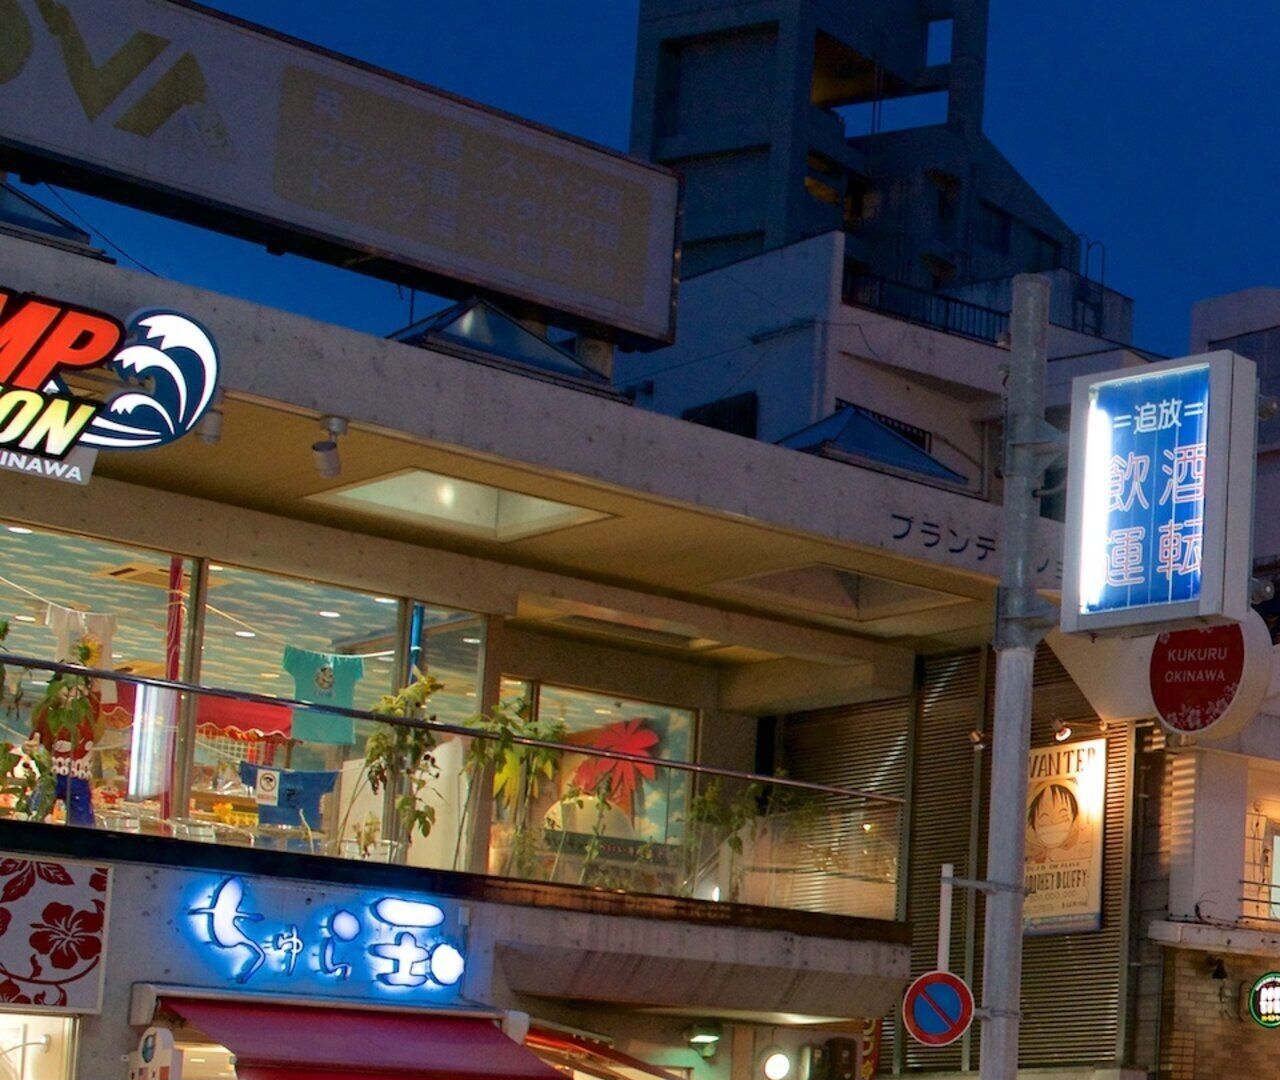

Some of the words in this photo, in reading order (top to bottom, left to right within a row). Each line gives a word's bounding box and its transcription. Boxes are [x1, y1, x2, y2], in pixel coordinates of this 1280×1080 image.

[0, 386, 97, 456] ON
[0, 452, 82, 482] INAWA
[1107, 442, 1207, 513] 飲酒
[1105, 519, 1203, 588] 運転
[1164, 669, 1226, 684] OKINAWA
[1167, 646, 1229, 663] KUKURU
